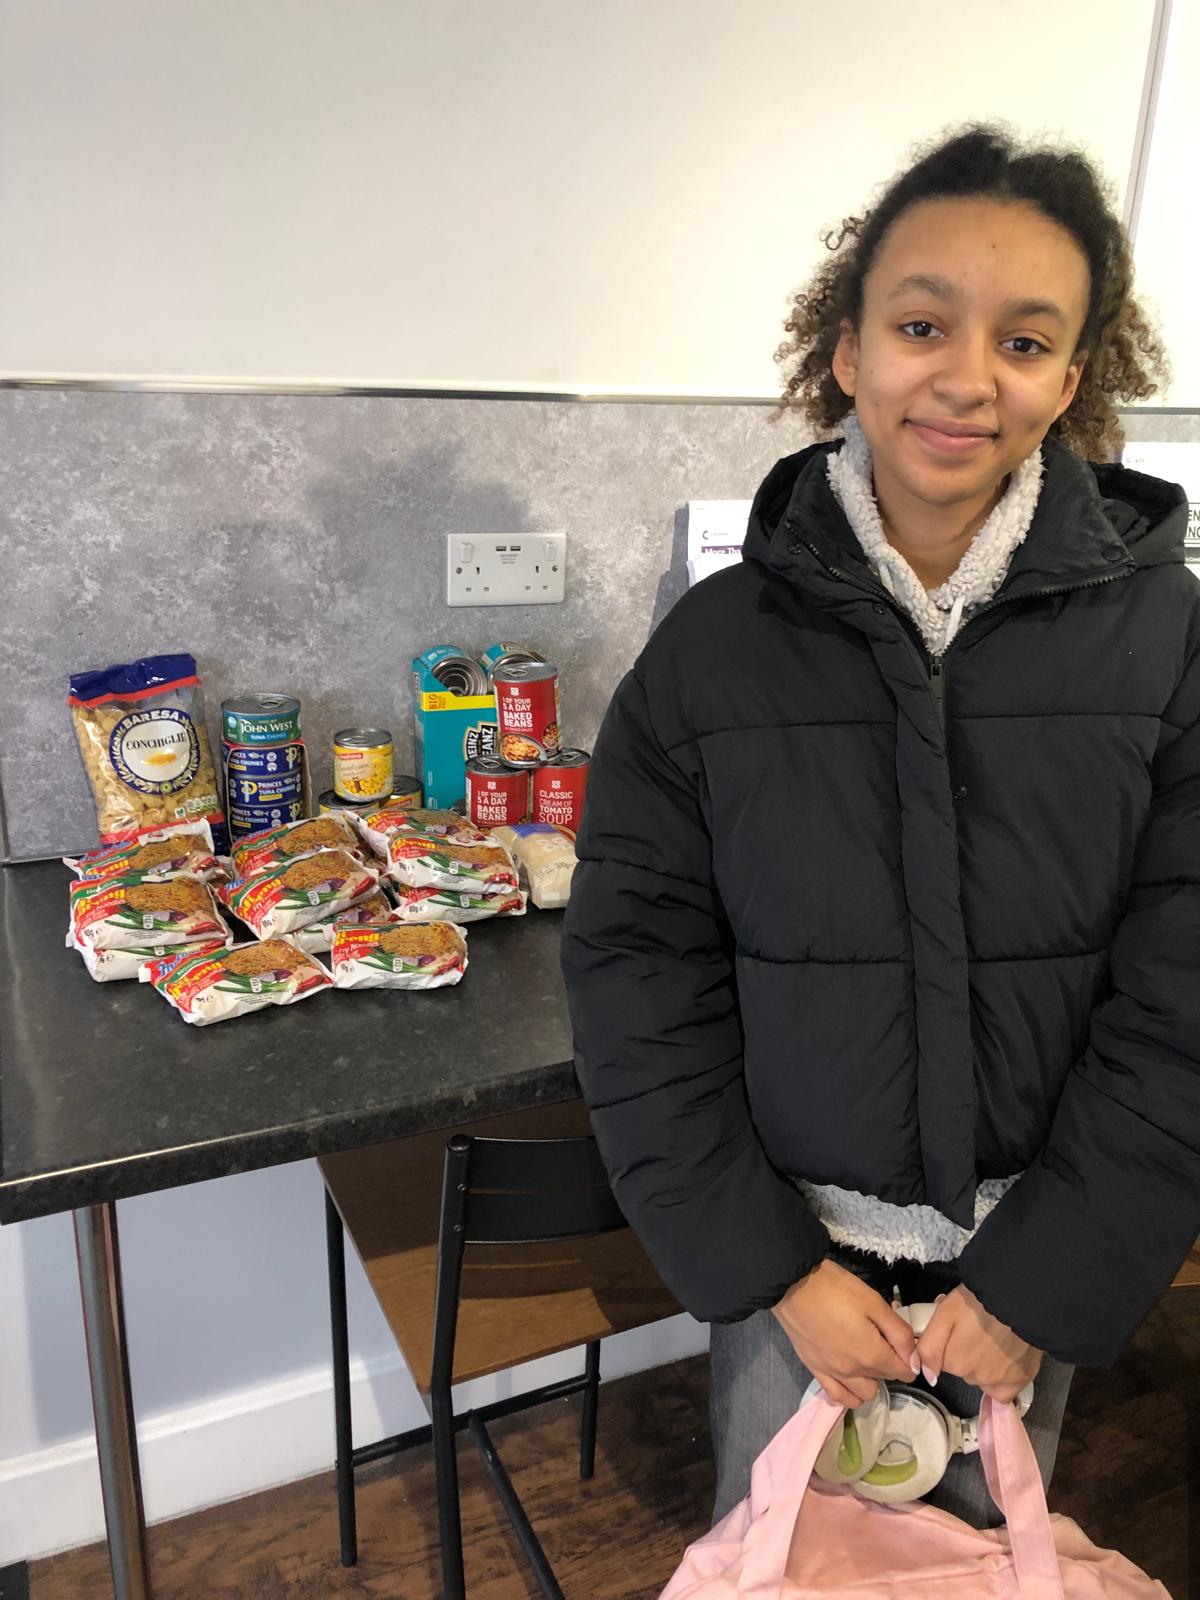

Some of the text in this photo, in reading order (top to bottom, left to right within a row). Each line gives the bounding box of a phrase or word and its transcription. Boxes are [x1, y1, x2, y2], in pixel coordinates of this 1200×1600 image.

[429, 694, 437, 709] BIG
[123, 709, 180, 729] BARESA
[503, 711, 532, 720] BAKED
[241, 719, 294, 733] JOHN WEST
[504, 719, 533, 728] BEANS
[126, 731, 187, 750] CONCHIGLIE
[539, 789, 574, 799] CLASSIC
[483, 797, 489, 805] A
[539, 798, 563, 807] CREAM
[477, 805, 507, 813] BAKED
[539, 805, 573, 814] TOMATO
[477, 812, 507, 821] BEANS
[539, 812, 573, 825] SOUP
